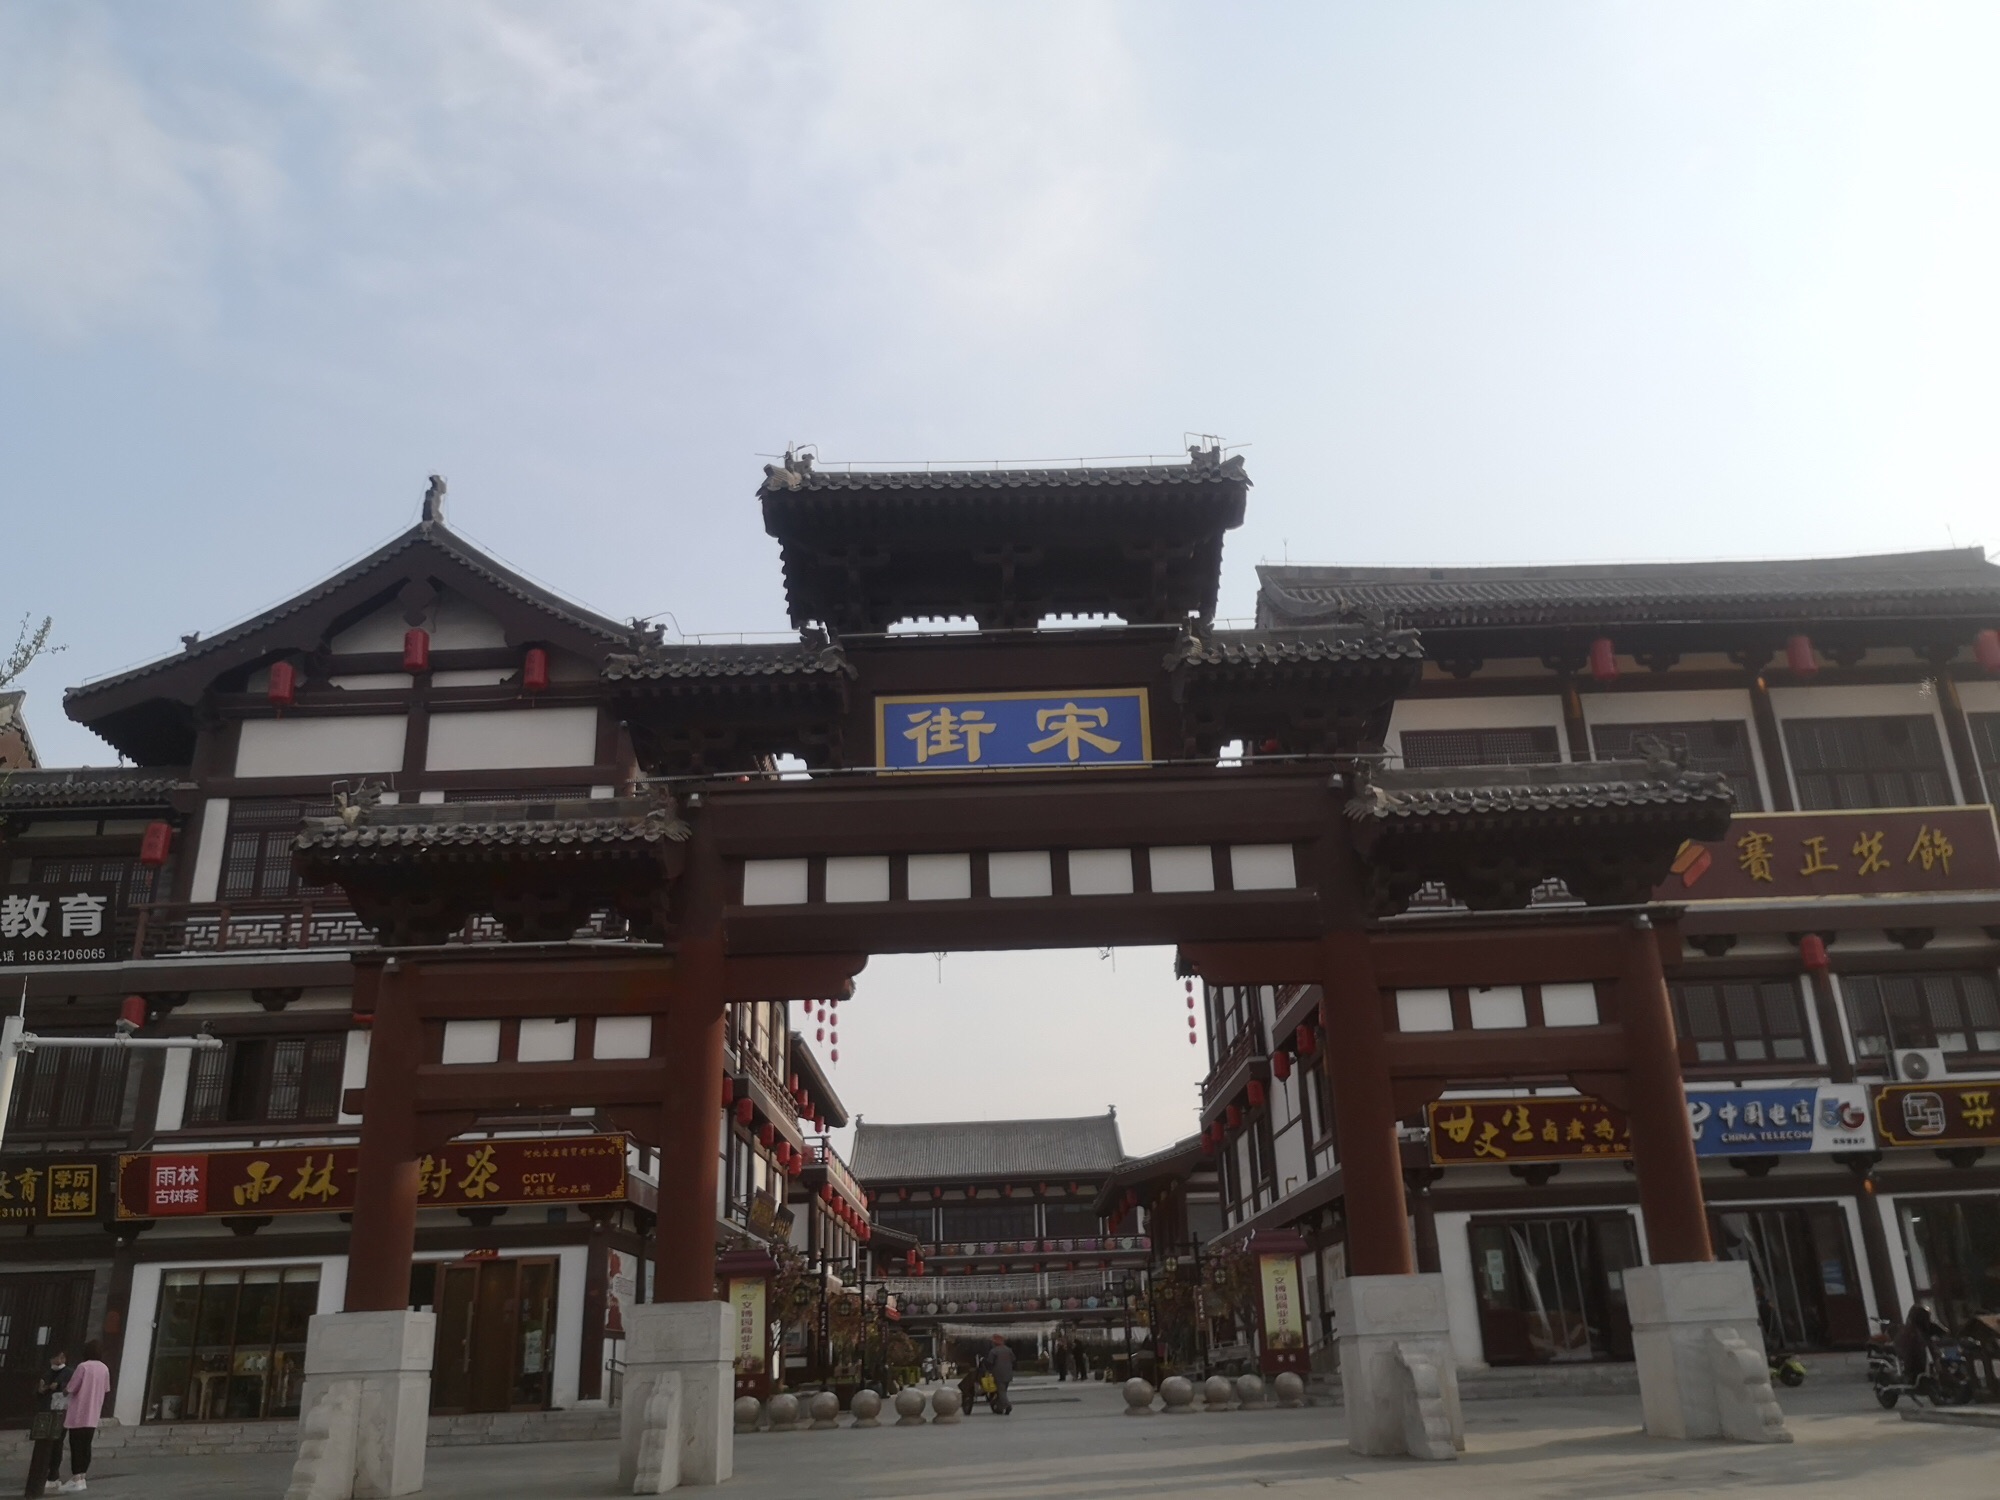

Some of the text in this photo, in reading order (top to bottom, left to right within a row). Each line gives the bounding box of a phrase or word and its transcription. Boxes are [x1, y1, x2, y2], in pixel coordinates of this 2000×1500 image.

[0, 892, 108, 939] 教育
[22, 948, 106, 962] 18632106065
[1718, 1098, 1812, 1130] 中国电信
[1819, 1097, 1866, 1132] 5G
[1720, 1129, 1814, 1144] CHINA TELECOM
[54, 1169, 90, 1188] 学历
[155, 1165, 199, 1187] 雨林
[521, 1172, 557, 1185] CCTV
[155, 1188, 199, 1205] 古树茶
